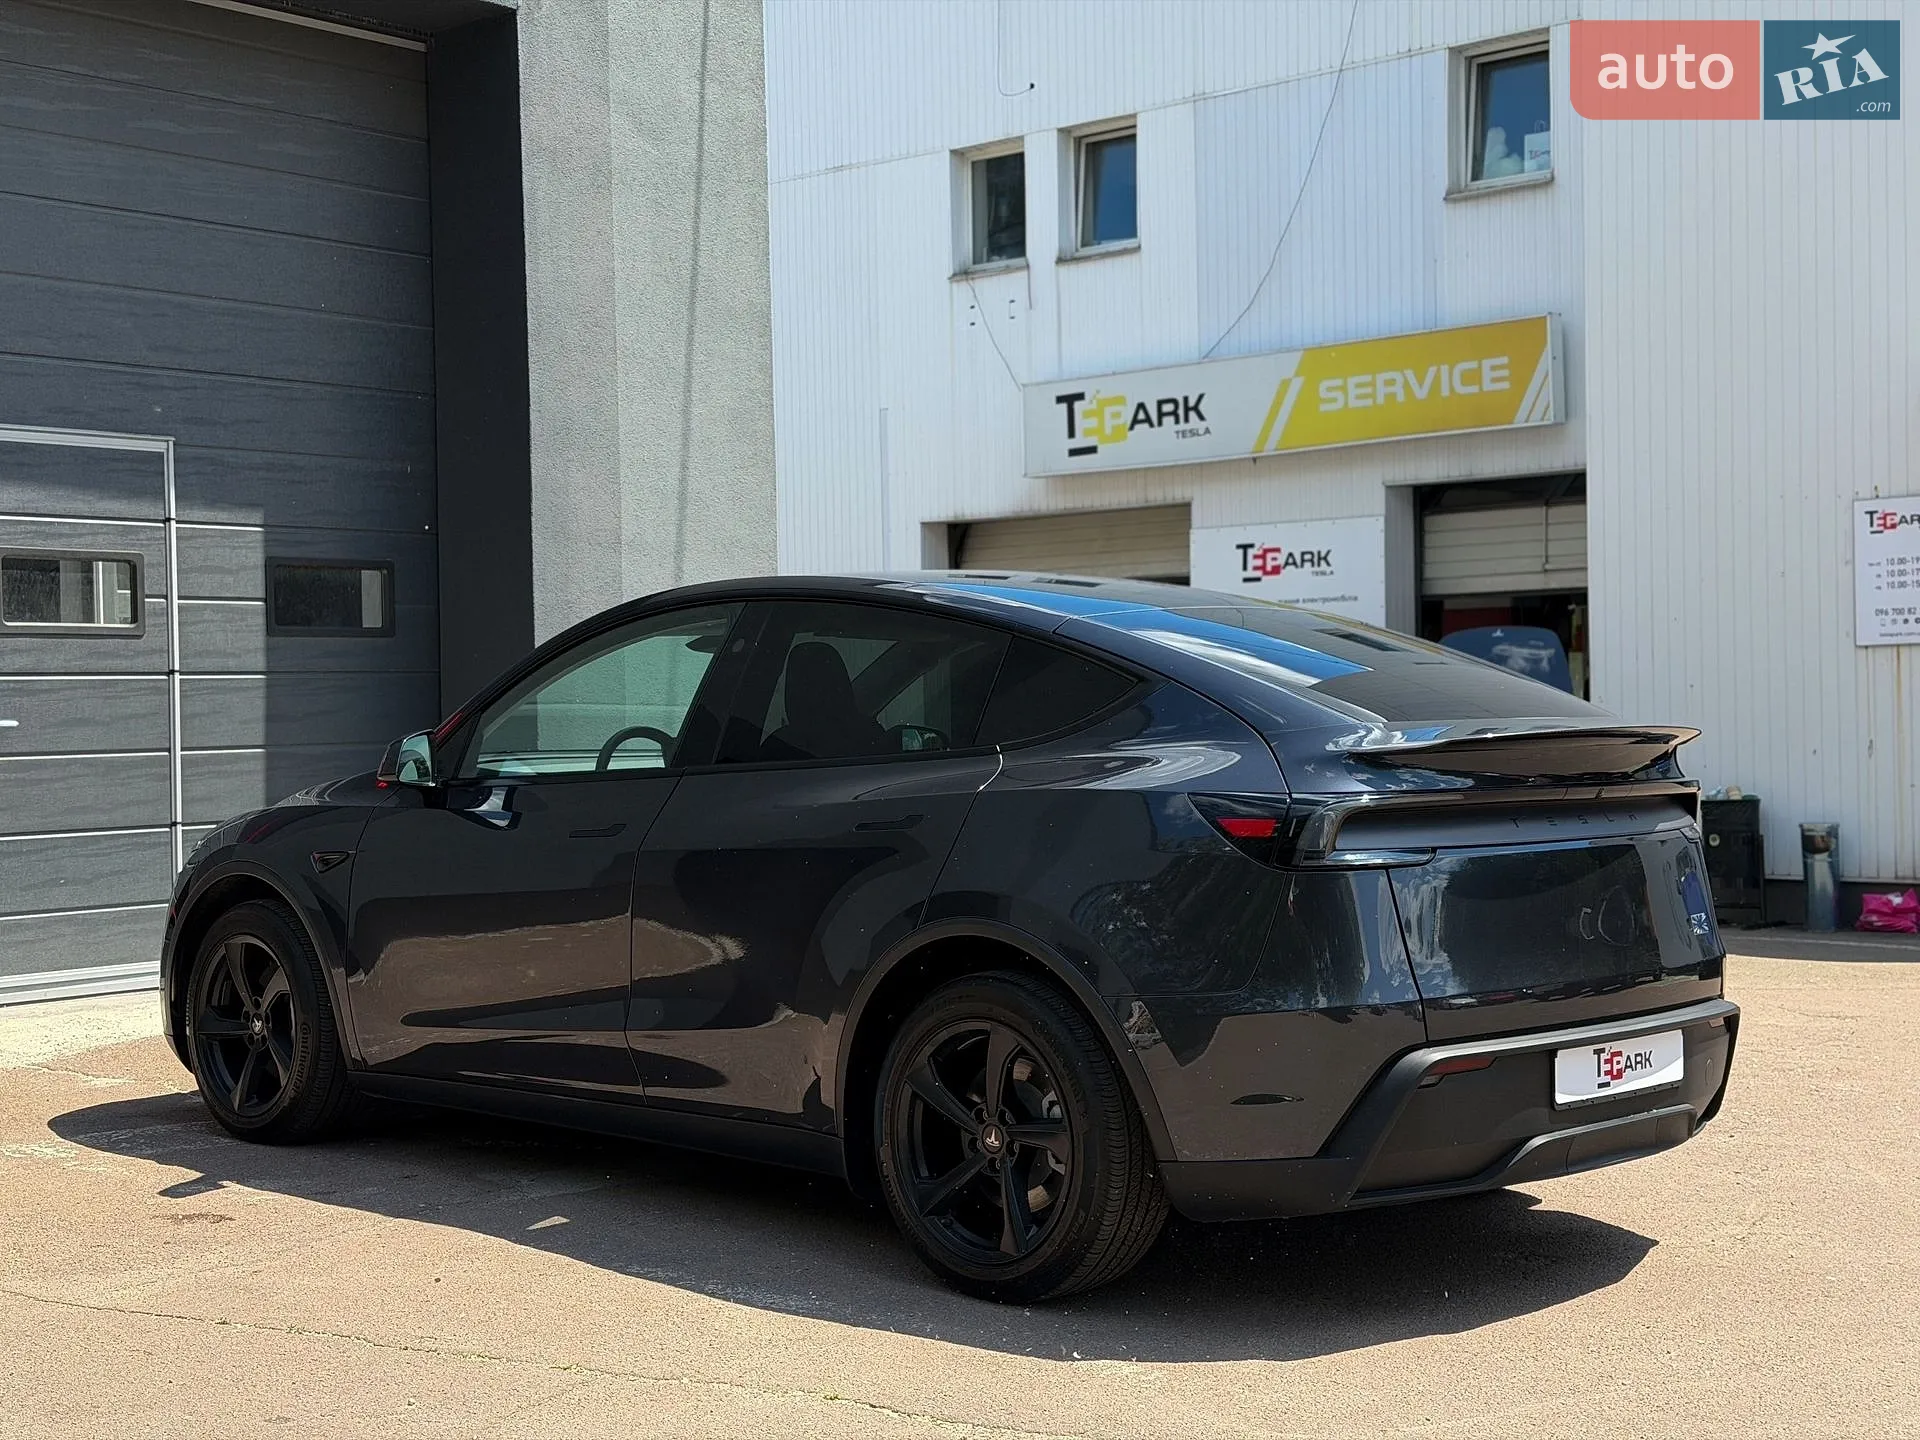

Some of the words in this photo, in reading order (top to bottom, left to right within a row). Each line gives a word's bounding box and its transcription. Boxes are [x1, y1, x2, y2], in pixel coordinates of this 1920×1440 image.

[1318, 356, 1511, 412] SERVICE
[1175, 425, 1212, 440] TESLA
[1509, 811, 1638, 828] TESLA
